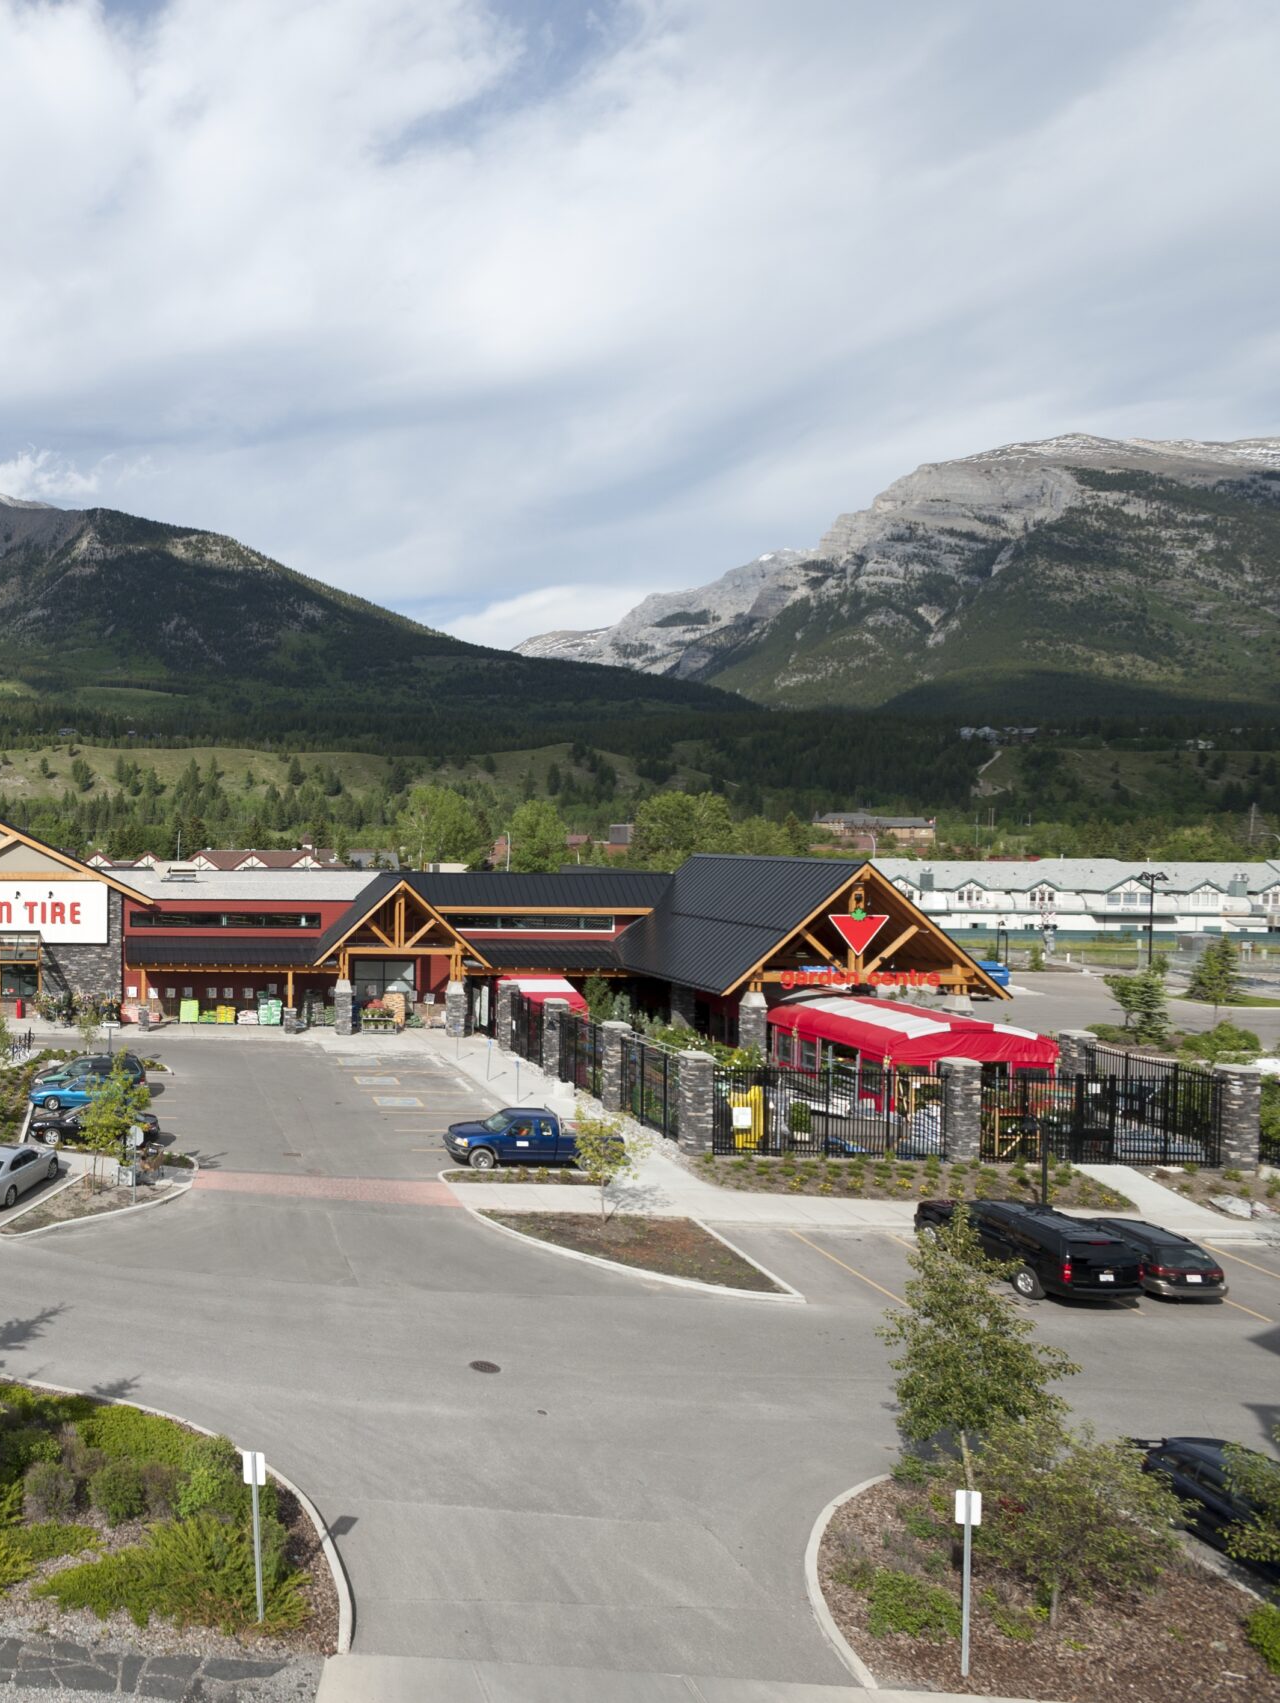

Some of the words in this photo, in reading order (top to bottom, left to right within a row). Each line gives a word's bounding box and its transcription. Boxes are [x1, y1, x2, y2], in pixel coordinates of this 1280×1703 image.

[24, 901, 81, 924] TIRE
[780, 966, 860, 990] garden
[866, 968, 941, 987] centre
